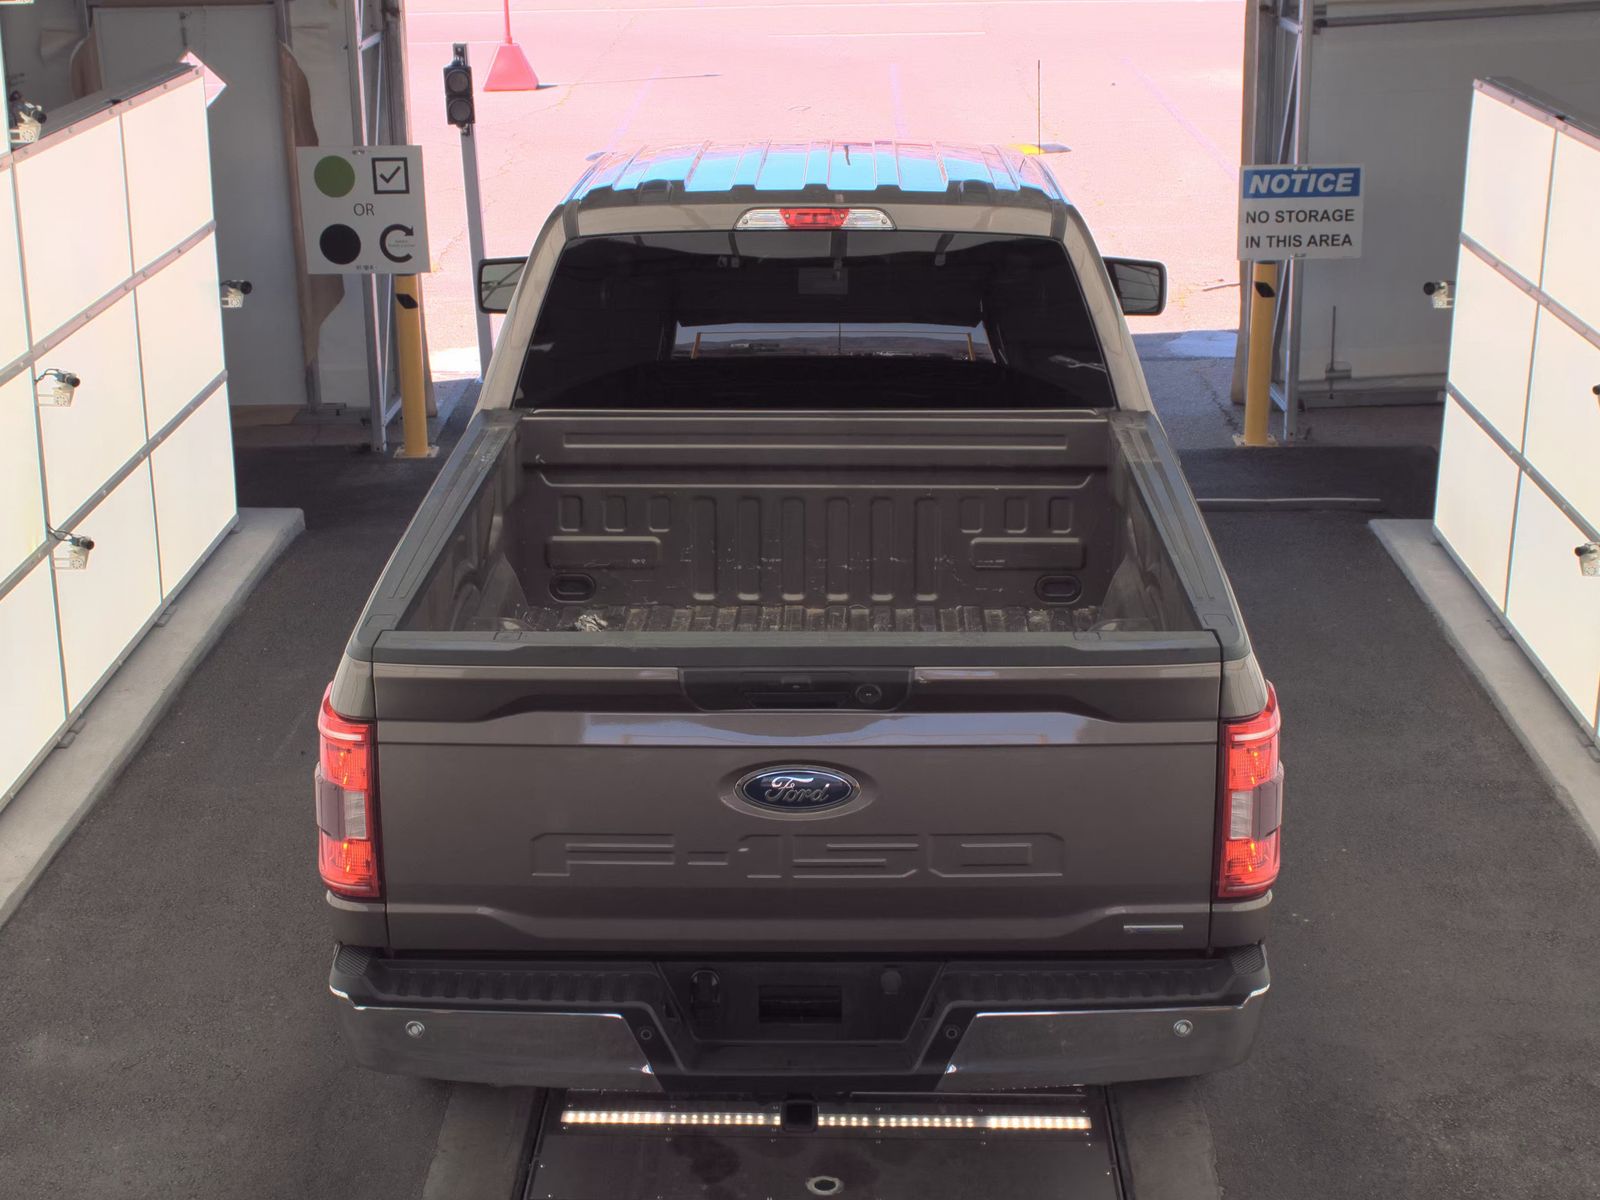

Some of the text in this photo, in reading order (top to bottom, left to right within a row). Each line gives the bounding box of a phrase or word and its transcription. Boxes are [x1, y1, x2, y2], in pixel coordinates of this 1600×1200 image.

[1248, 172, 1355, 194] NOTICE
[353, 202, 375, 217] OR
[1246, 208, 1355, 224] NO STORAGE
[1245, 233, 1353, 249] IN THIS AREA
[764, 776, 831, 802] Ford
[530, 832, 1066, 878] F-150
